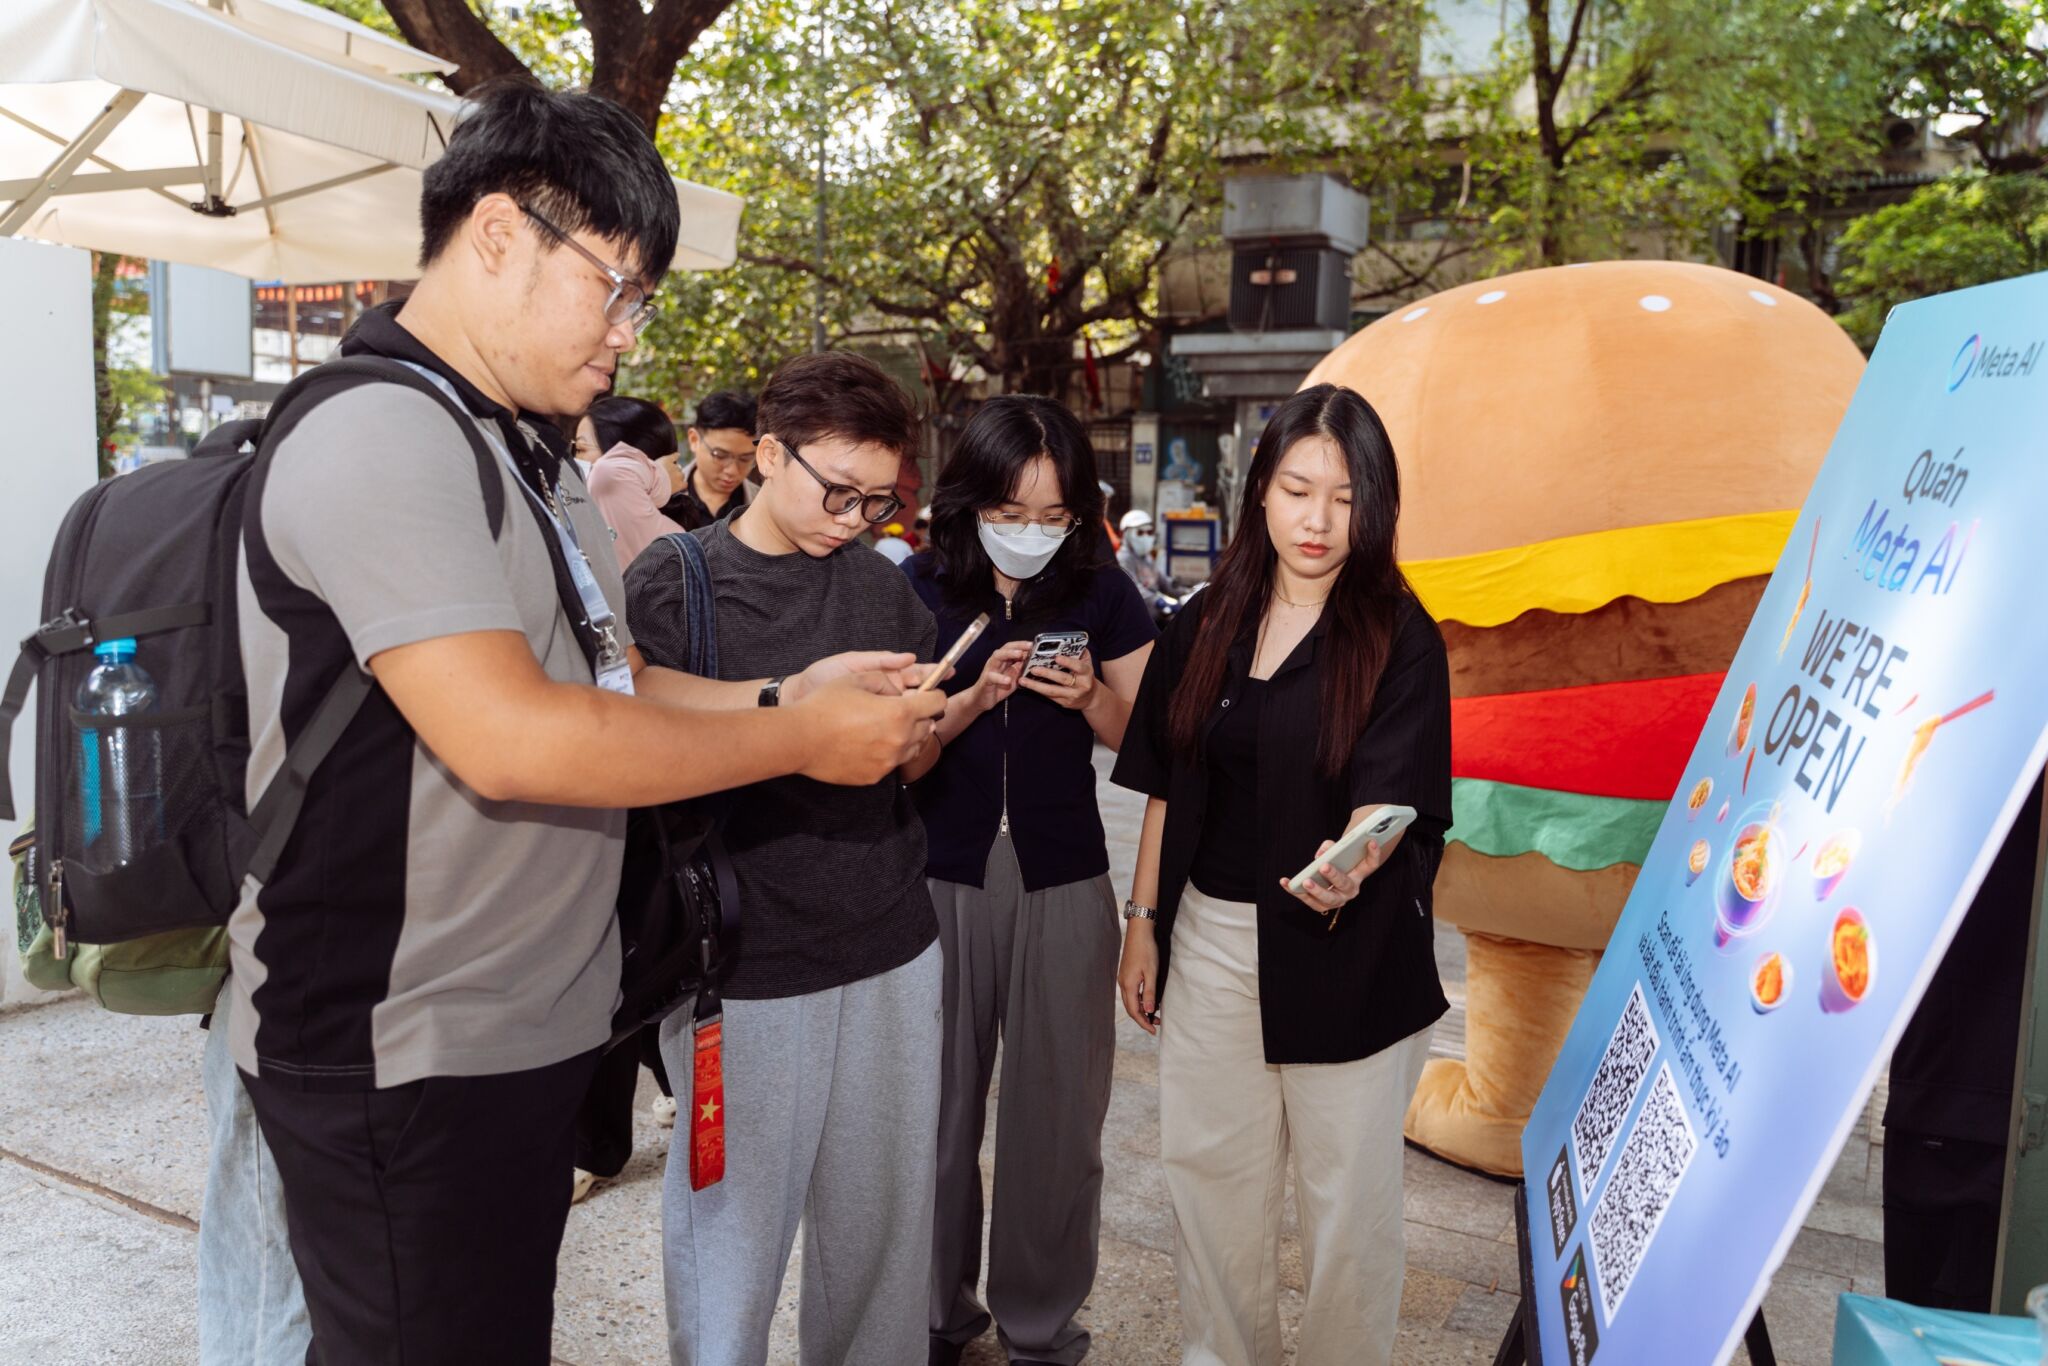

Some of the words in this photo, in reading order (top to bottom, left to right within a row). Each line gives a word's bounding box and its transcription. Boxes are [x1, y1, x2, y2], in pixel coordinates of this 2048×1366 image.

[1971, 344, 2019, 378] Meta
[2013, 341, 2045, 376] AI
[1903, 446, 1969, 508] Quán
[1842, 498, 1921, 592] Meta
[1911, 518, 1981, 595] AI
[1800, 608, 1909, 720] WE'RE
[1764, 684, 1867, 815] OPEN
[1657, 910, 1672, 948] Scan
[1690, 989, 1710, 1040] dụng
[1705, 1019, 1729, 1073] Meta
[1723, 1061, 1741, 1094] AI
